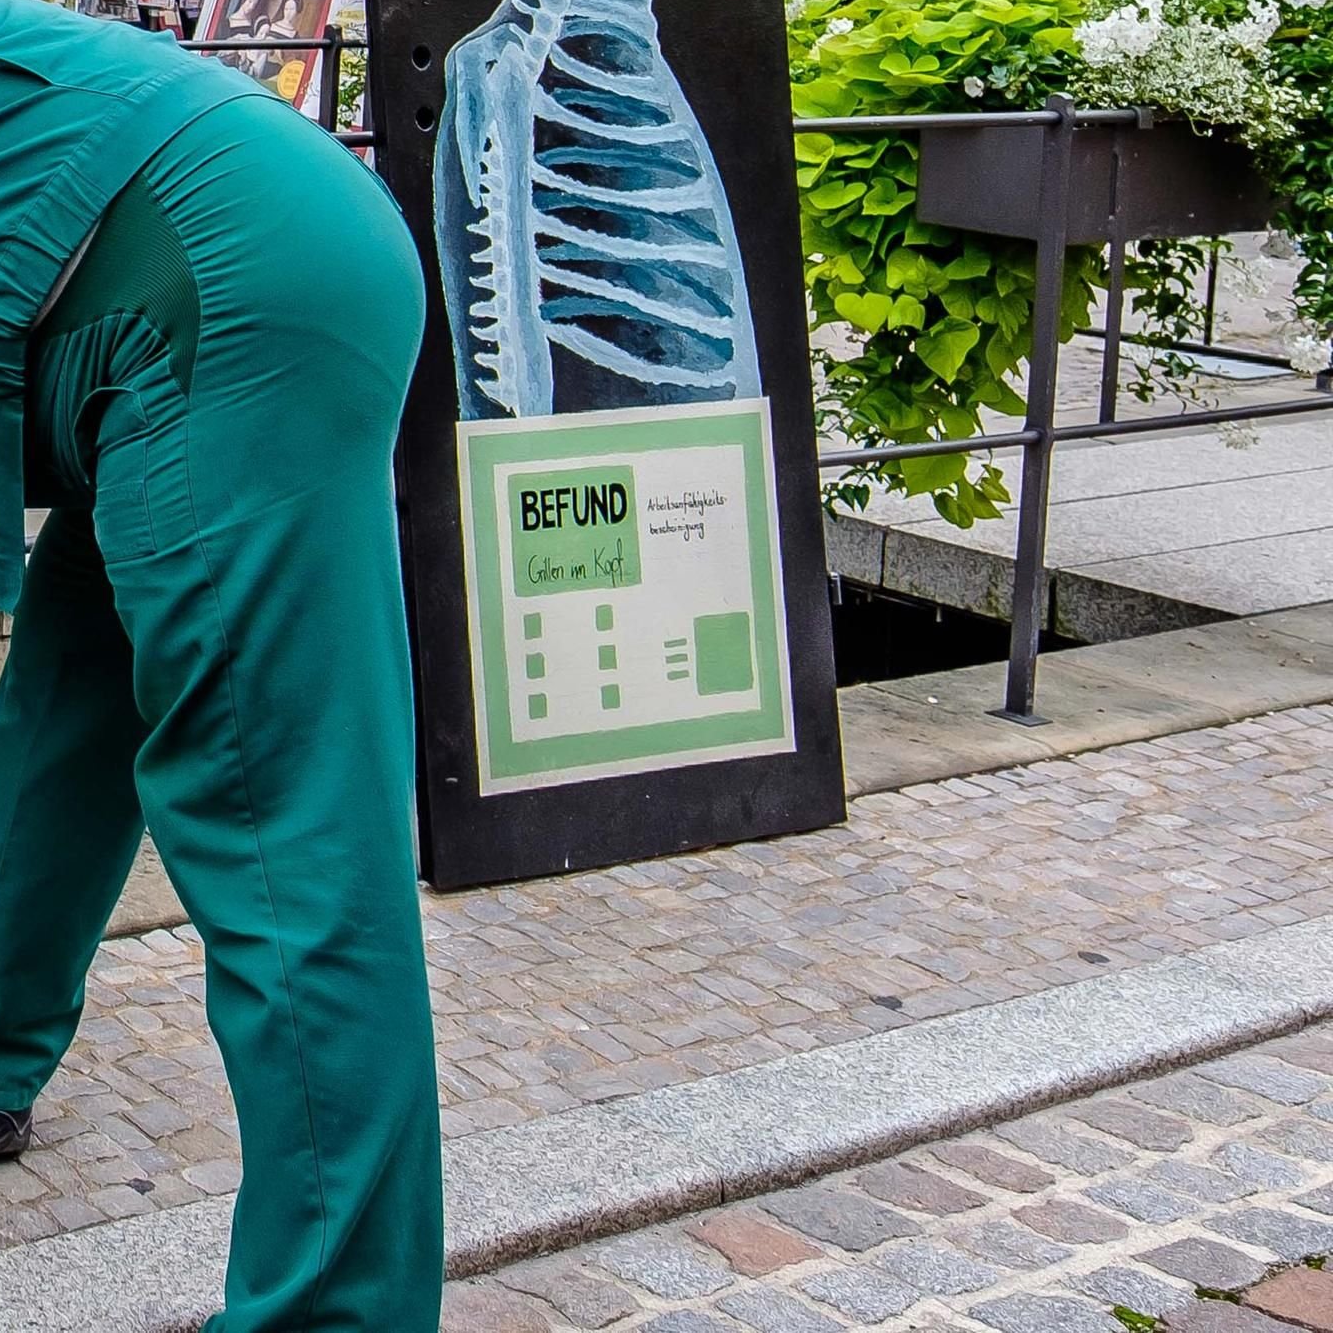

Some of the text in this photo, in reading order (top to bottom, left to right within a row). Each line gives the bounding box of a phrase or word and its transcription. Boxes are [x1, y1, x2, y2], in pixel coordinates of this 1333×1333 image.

[520, 482, 628, 532] BEFUND
[570, 559, 587, 580] im
[593, 537, 624, 588] Kopf
